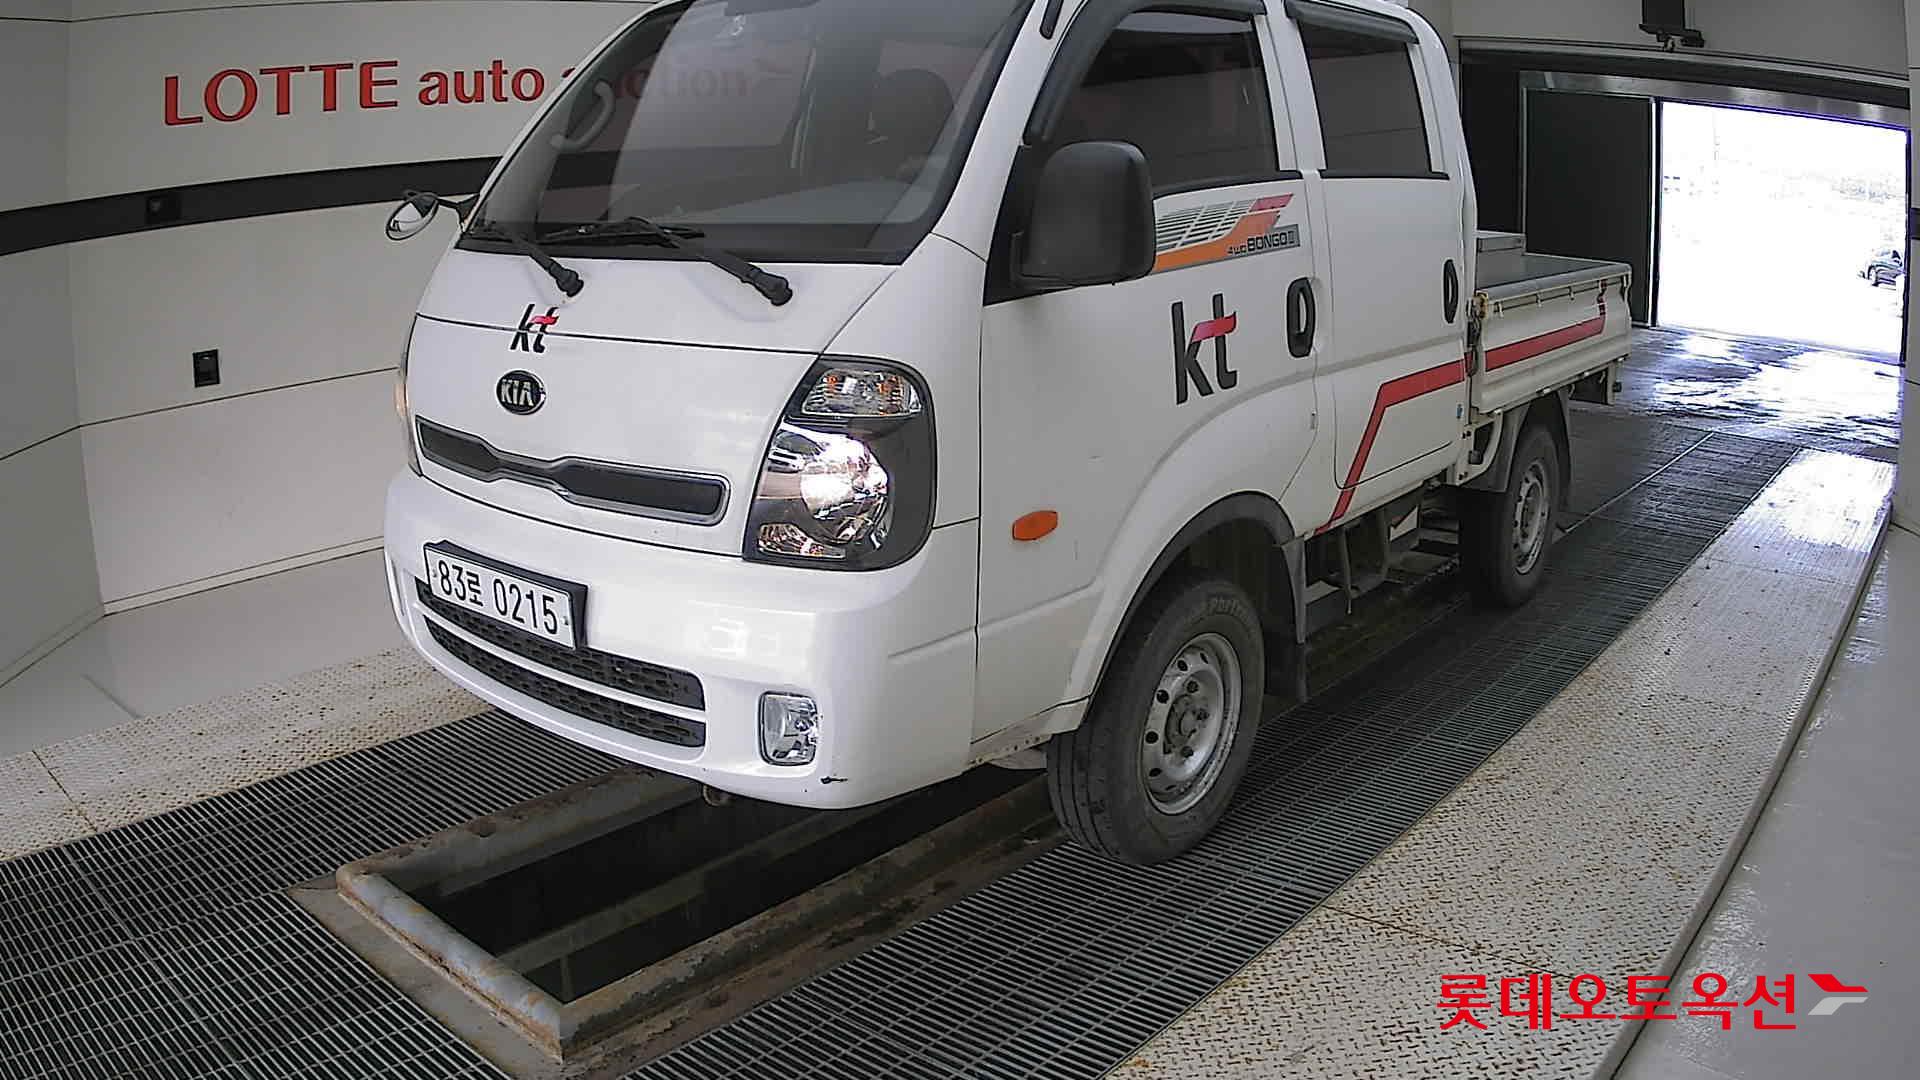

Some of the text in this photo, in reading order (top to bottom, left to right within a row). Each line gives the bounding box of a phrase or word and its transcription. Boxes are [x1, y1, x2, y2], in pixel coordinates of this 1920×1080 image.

[163, 60, 398, 126] LOTTE
[417, 59, 545, 106] auto
[1247, 231, 1287, 252] BONGO
[509, 303, 560, 354] kt
[1171, 292, 1238, 405] kt
[501, 379, 534, 407] KIA
[438, 559, 558, 635] 83로 0215
